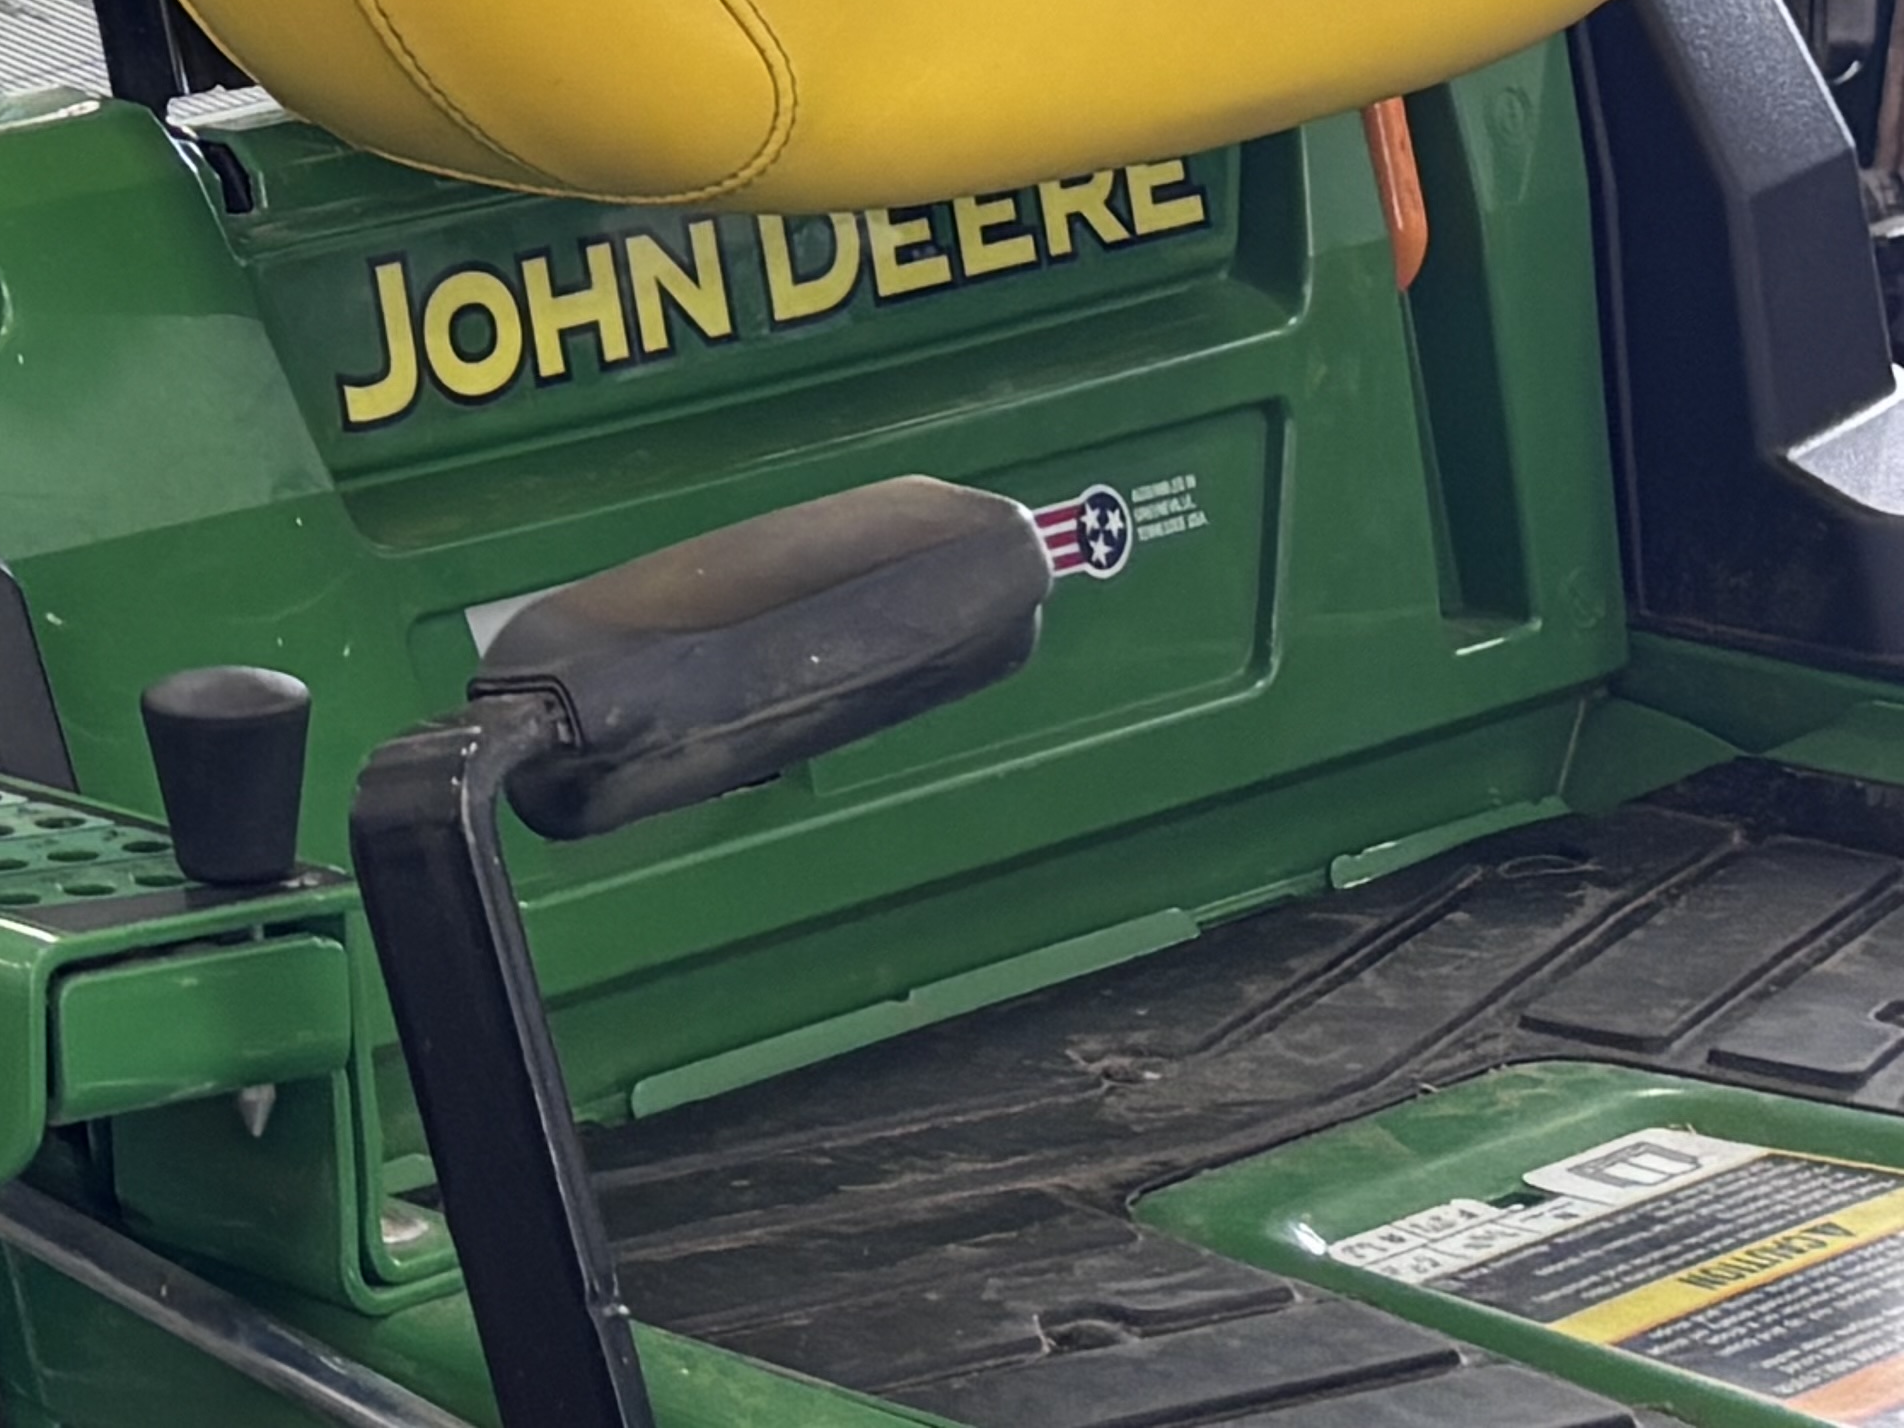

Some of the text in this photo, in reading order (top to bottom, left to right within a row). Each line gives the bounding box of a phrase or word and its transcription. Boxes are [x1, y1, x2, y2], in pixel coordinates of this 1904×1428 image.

[341, 156, 1206, 427] JOHN DEERE
[1676, 1234, 1829, 1291] CAUTION
